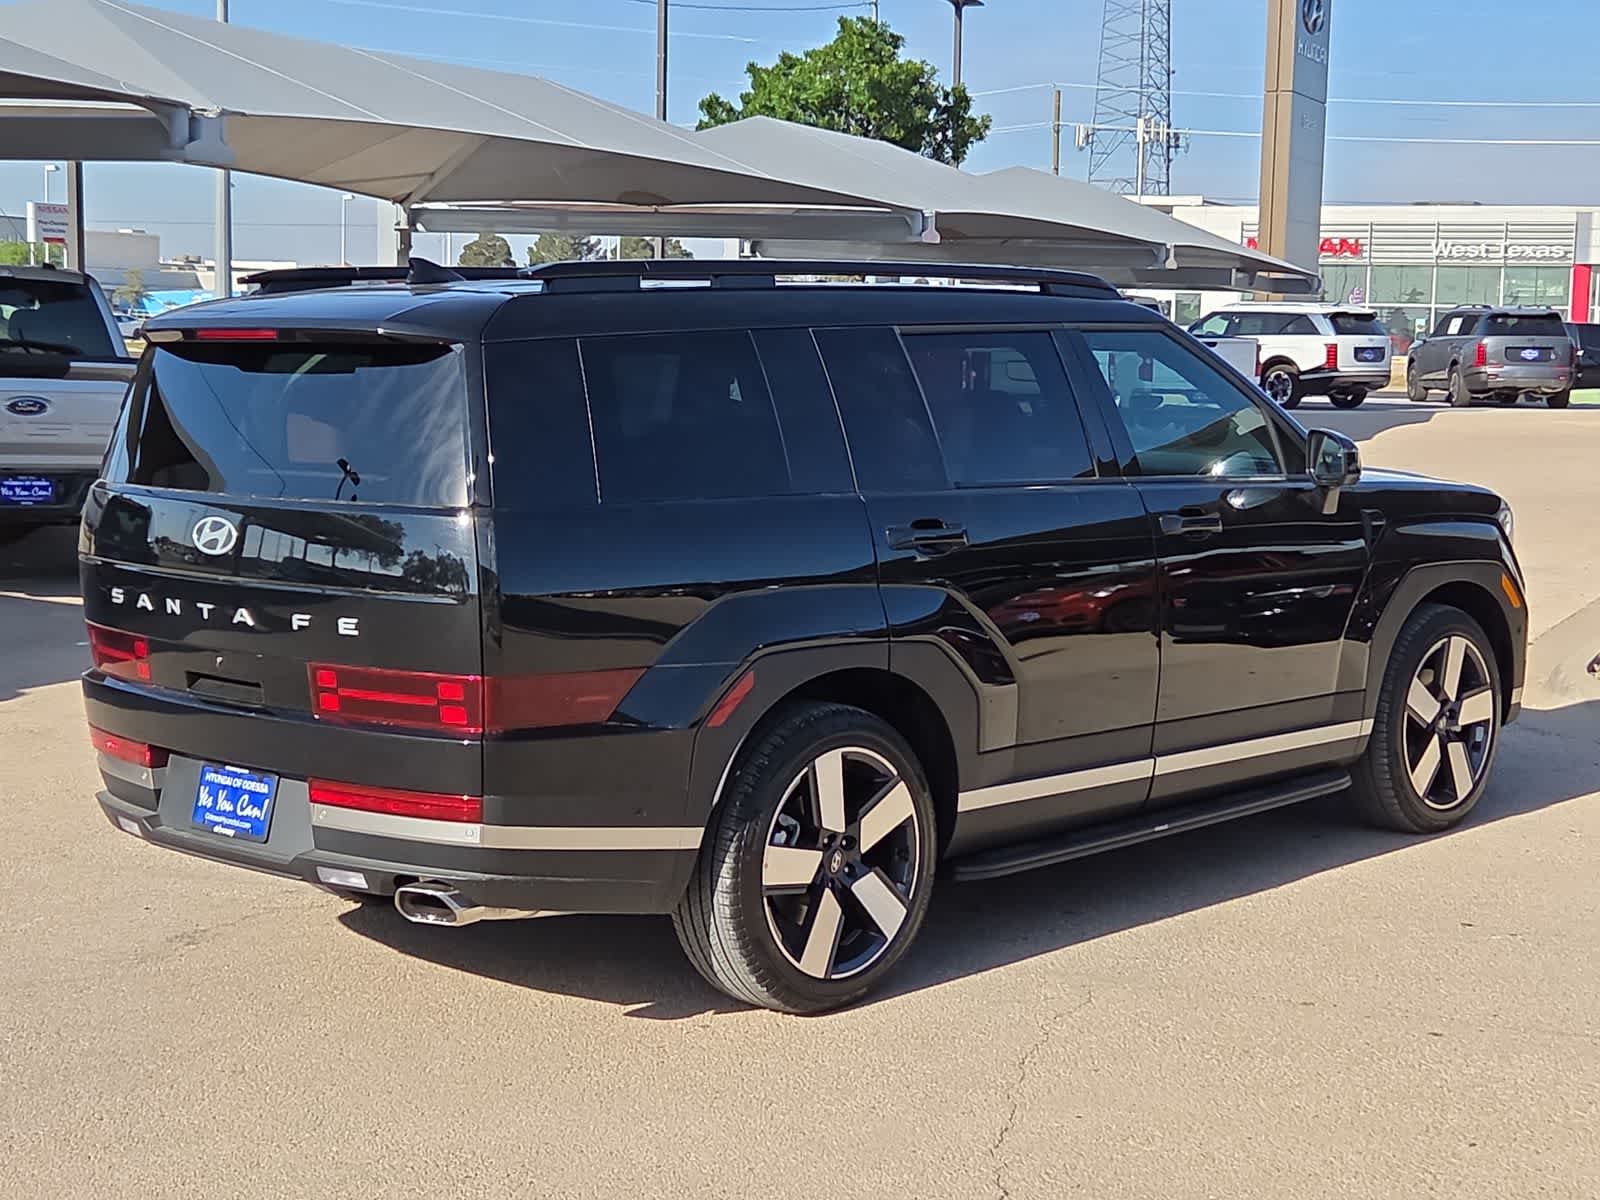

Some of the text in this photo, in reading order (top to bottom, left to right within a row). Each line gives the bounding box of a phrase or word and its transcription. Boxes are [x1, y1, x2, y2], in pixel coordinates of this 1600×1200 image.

[1432, 241, 1565, 257] West Texas
[111, 588, 360, 637] SANTA FE
[206, 773, 269, 794] HYUNDAI OF ODESSA
[198, 786, 270, 821] Yes You Can!
